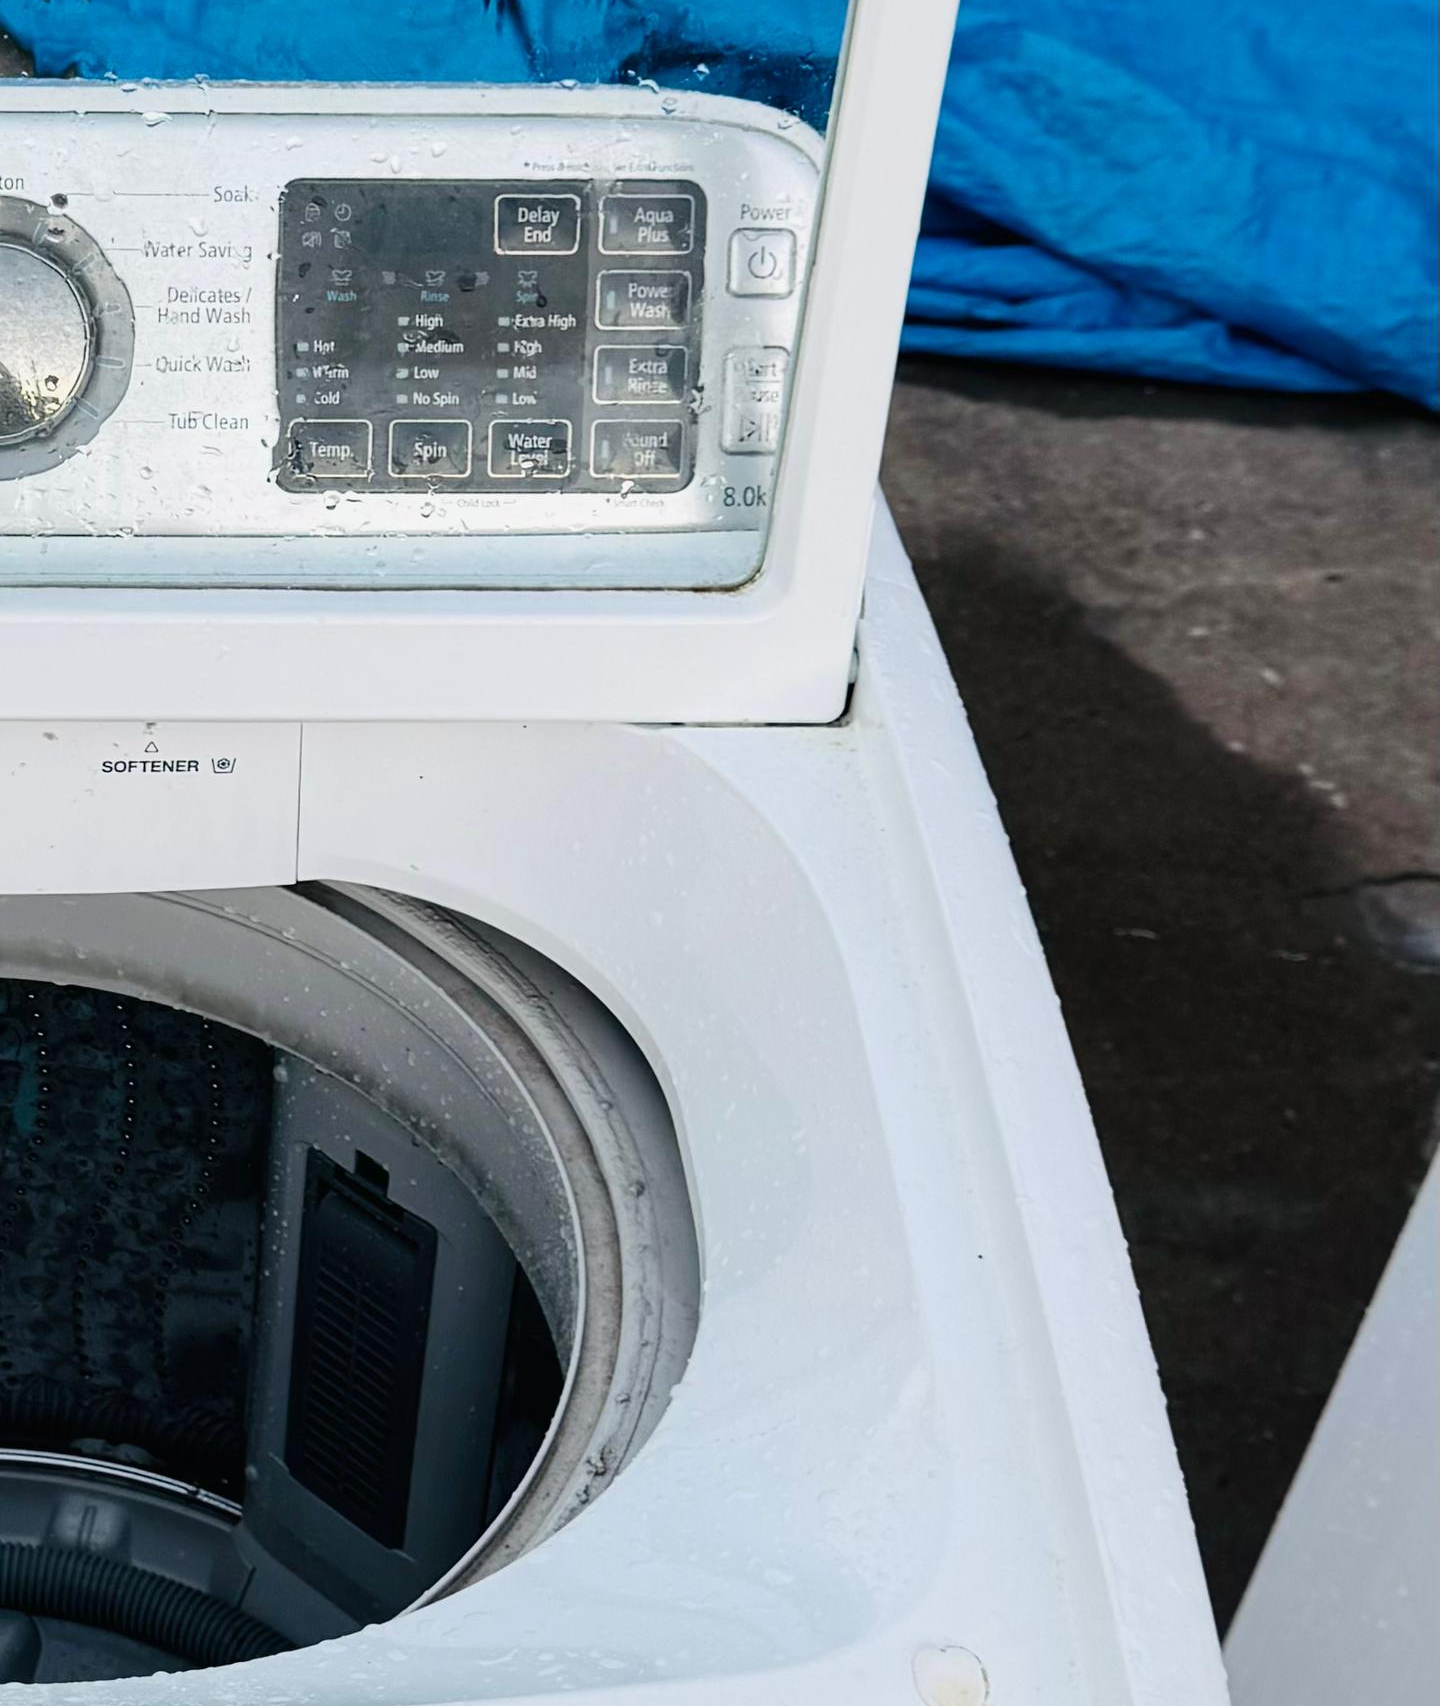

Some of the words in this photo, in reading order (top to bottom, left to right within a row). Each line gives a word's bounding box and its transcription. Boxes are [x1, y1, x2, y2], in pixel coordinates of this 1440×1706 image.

[214, 185, 254, 202] Soak
[518, 207, 560, 226] Delay
[633, 207, 674, 226] Aqua
[741, 204, 791, 221] Power
[524, 227, 552, 243] End
[638, 227, 670, 242] Plus
[144, 240, 193, 258] Water
[199, 241, 252, 263] Savig
[167, 286, 241, 303] Delicates
[327, 290, 357, 302] Wash
[421, 290, 450, 302] Rinse
[628, 283, 672, 299] Powe
[157, 307, 200, 324] Hand
[206, 307, 251, 324] Wash
[630, 302, 671, 320] Wash
[415, 314, 444, 330] High
[515, 314, 546, 329] Extra
[547, 314, 577, 331] High
[415, 339, 464, 353] Medium
[155, 355, 202, 373] Quick
[629, 358, 668, 374] Extra
[413, 367, 440, 379] Low
[513, 366, 537, 379] Mid
[627, 377, 668, 393] Rinse
[412, 392, 431, 405] No
[433, 392, 460, 407] Spin
[512, 392, 538, 405] Low
[168, 412, 198, 430] Tub
[202, 413, 249, 430] Clean
[508, 433, 553, 449] Water
[309, 441, 355, 459] Temp.
[414, 441, 448, 460] Spin
[634, 449, 656, 467] Off
[101, 759, 200, 773] SOFTENER
